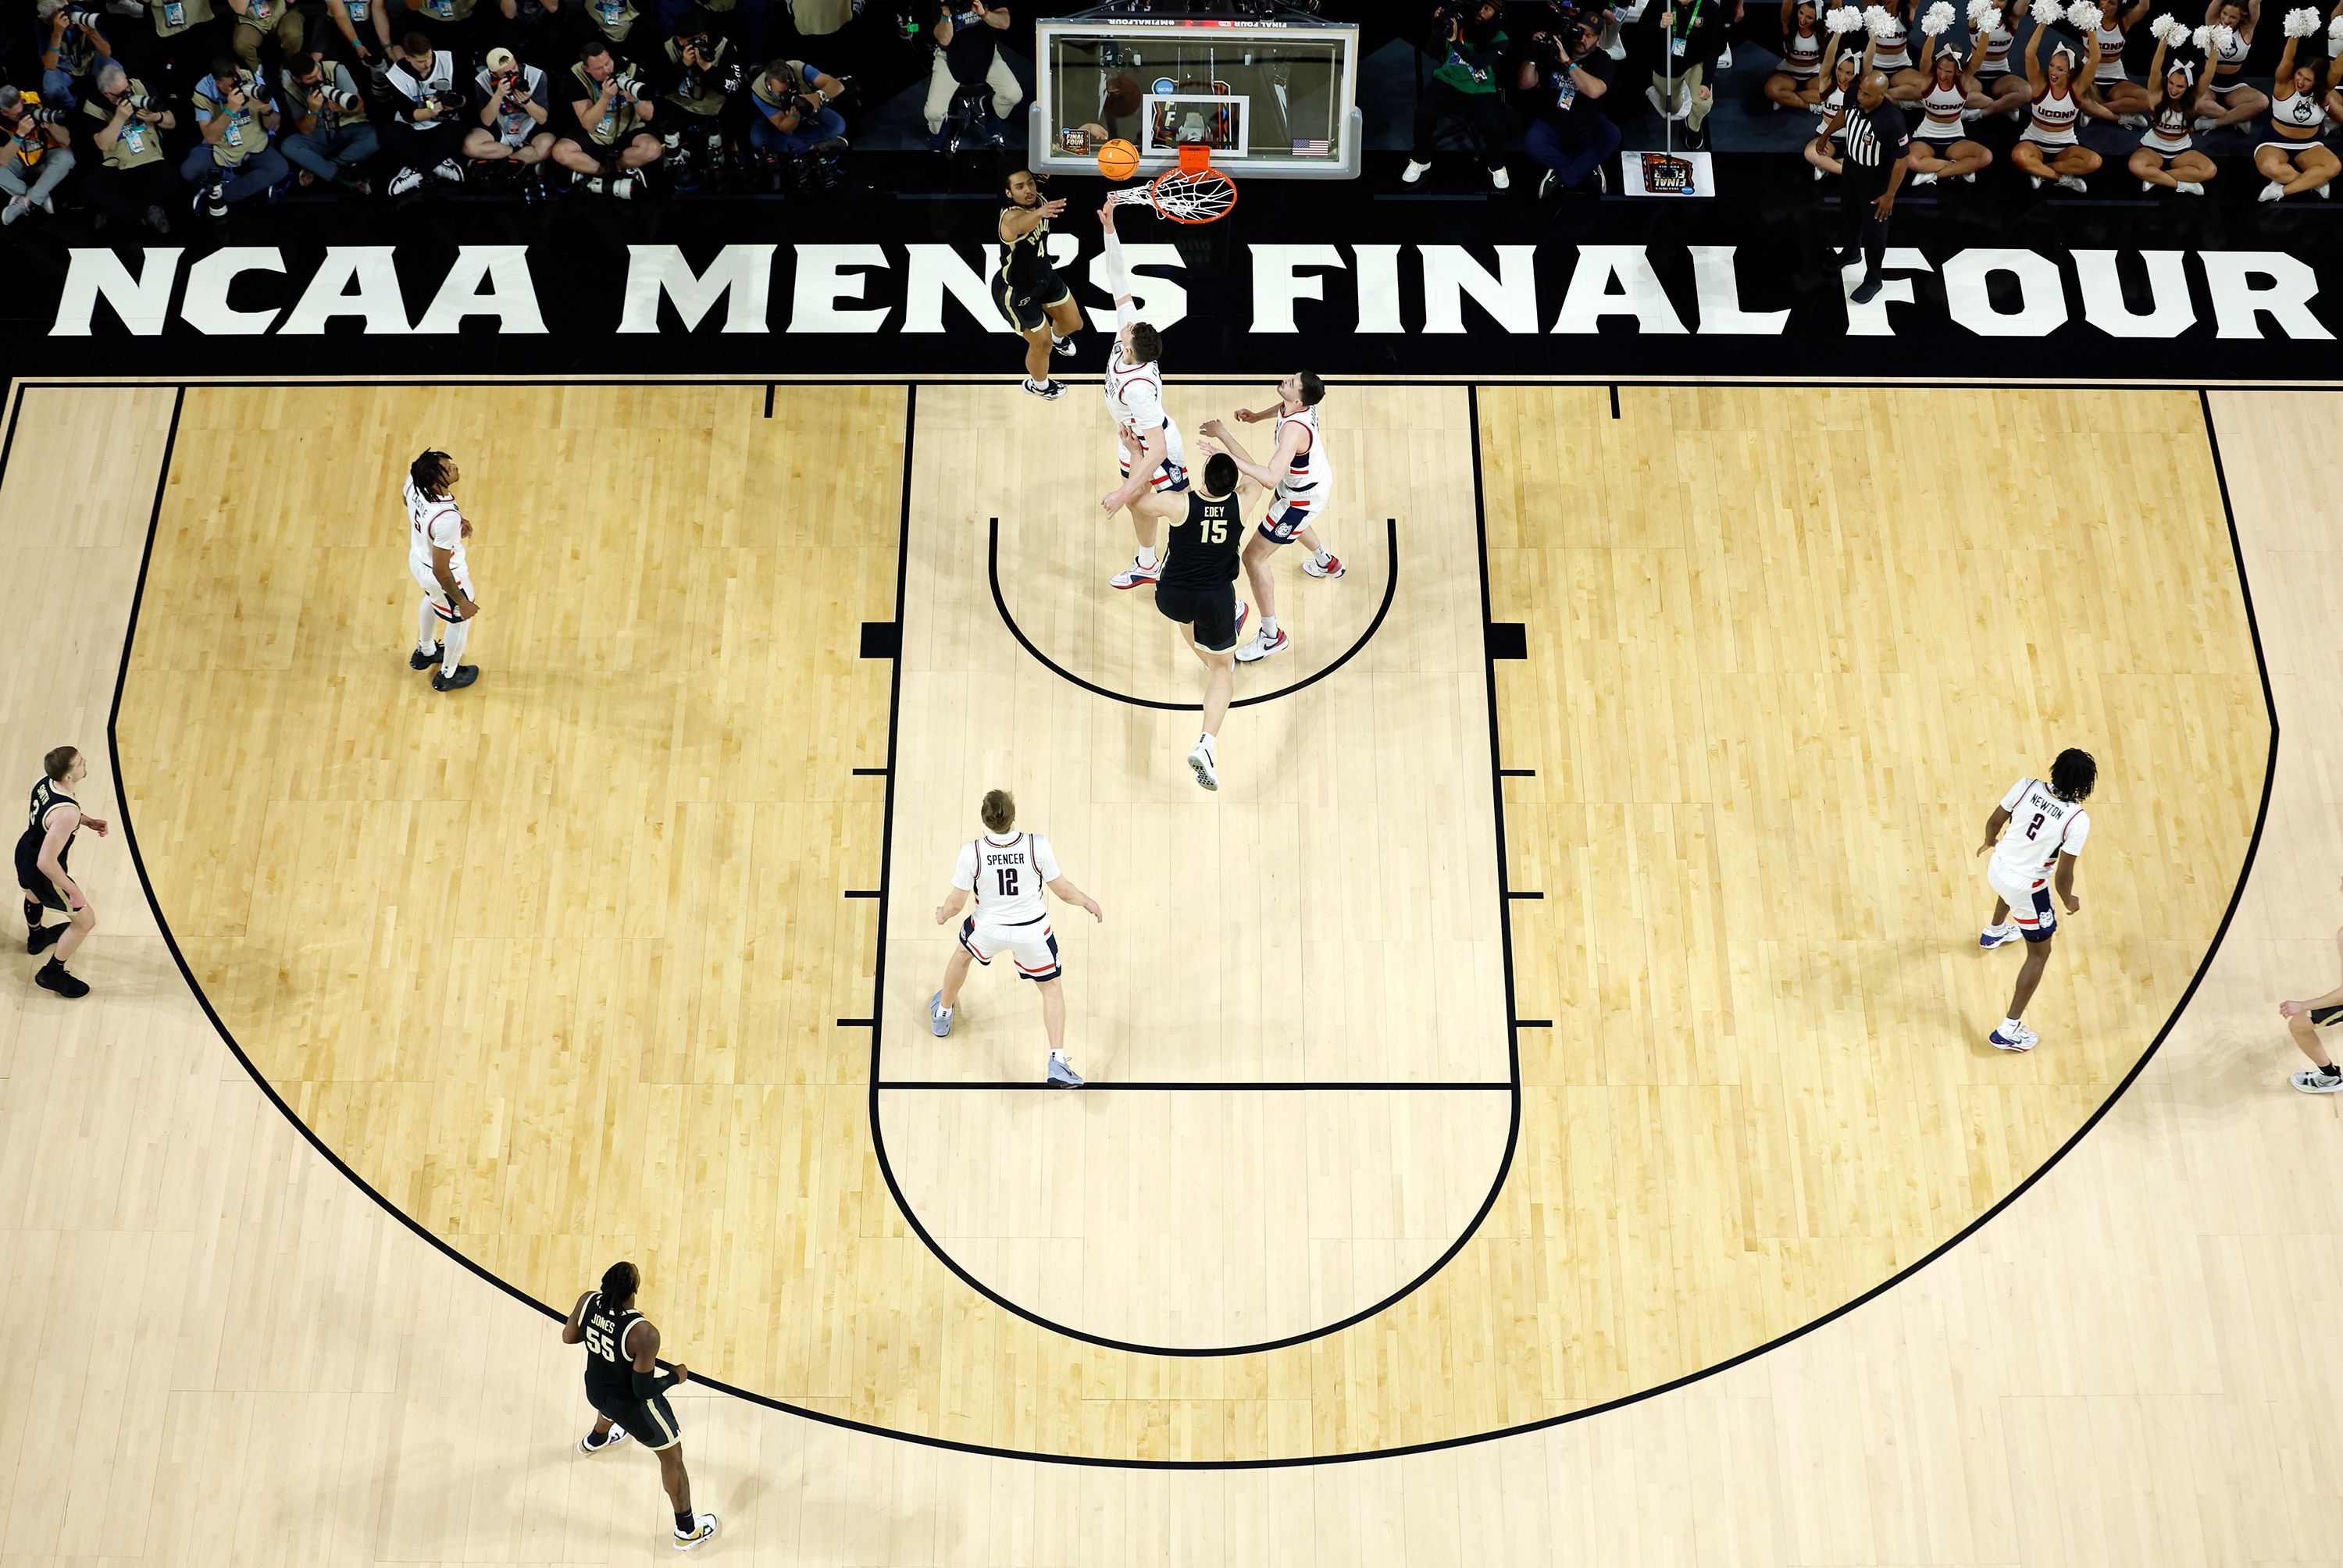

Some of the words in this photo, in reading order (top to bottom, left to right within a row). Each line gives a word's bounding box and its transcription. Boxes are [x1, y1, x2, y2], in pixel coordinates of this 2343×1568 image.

[2038, 106, 2076, 118] UCONN
[1654, 178, 1687, 187] FINAL
[1037, 240, 1045, 258] 4
[48, 244, 551, 336] NCAA
[615, 233, 1187, 334] MEN'S
[1247, 244, 1792, 335] FINAL
[1833, 248, 2338, 340] FOUR
[414, 509, 422, 534] 5
[1204, 506, 1225, 517] EDEY
[1200, 520, 1228, 543] 15
[37, 783, 50, 806] SMITH
[30, 799, 40, 826] 3
[2030, 793, 2064, 821] NEWTON
[2026, 813, 2045, 841] 2
[986, 853, 1025, 866] SPENCER
[997, 868, 1019, 896] 12
[590, 1313, 615, 1335] JONES
[586, 1325, 615, 1363] 55
